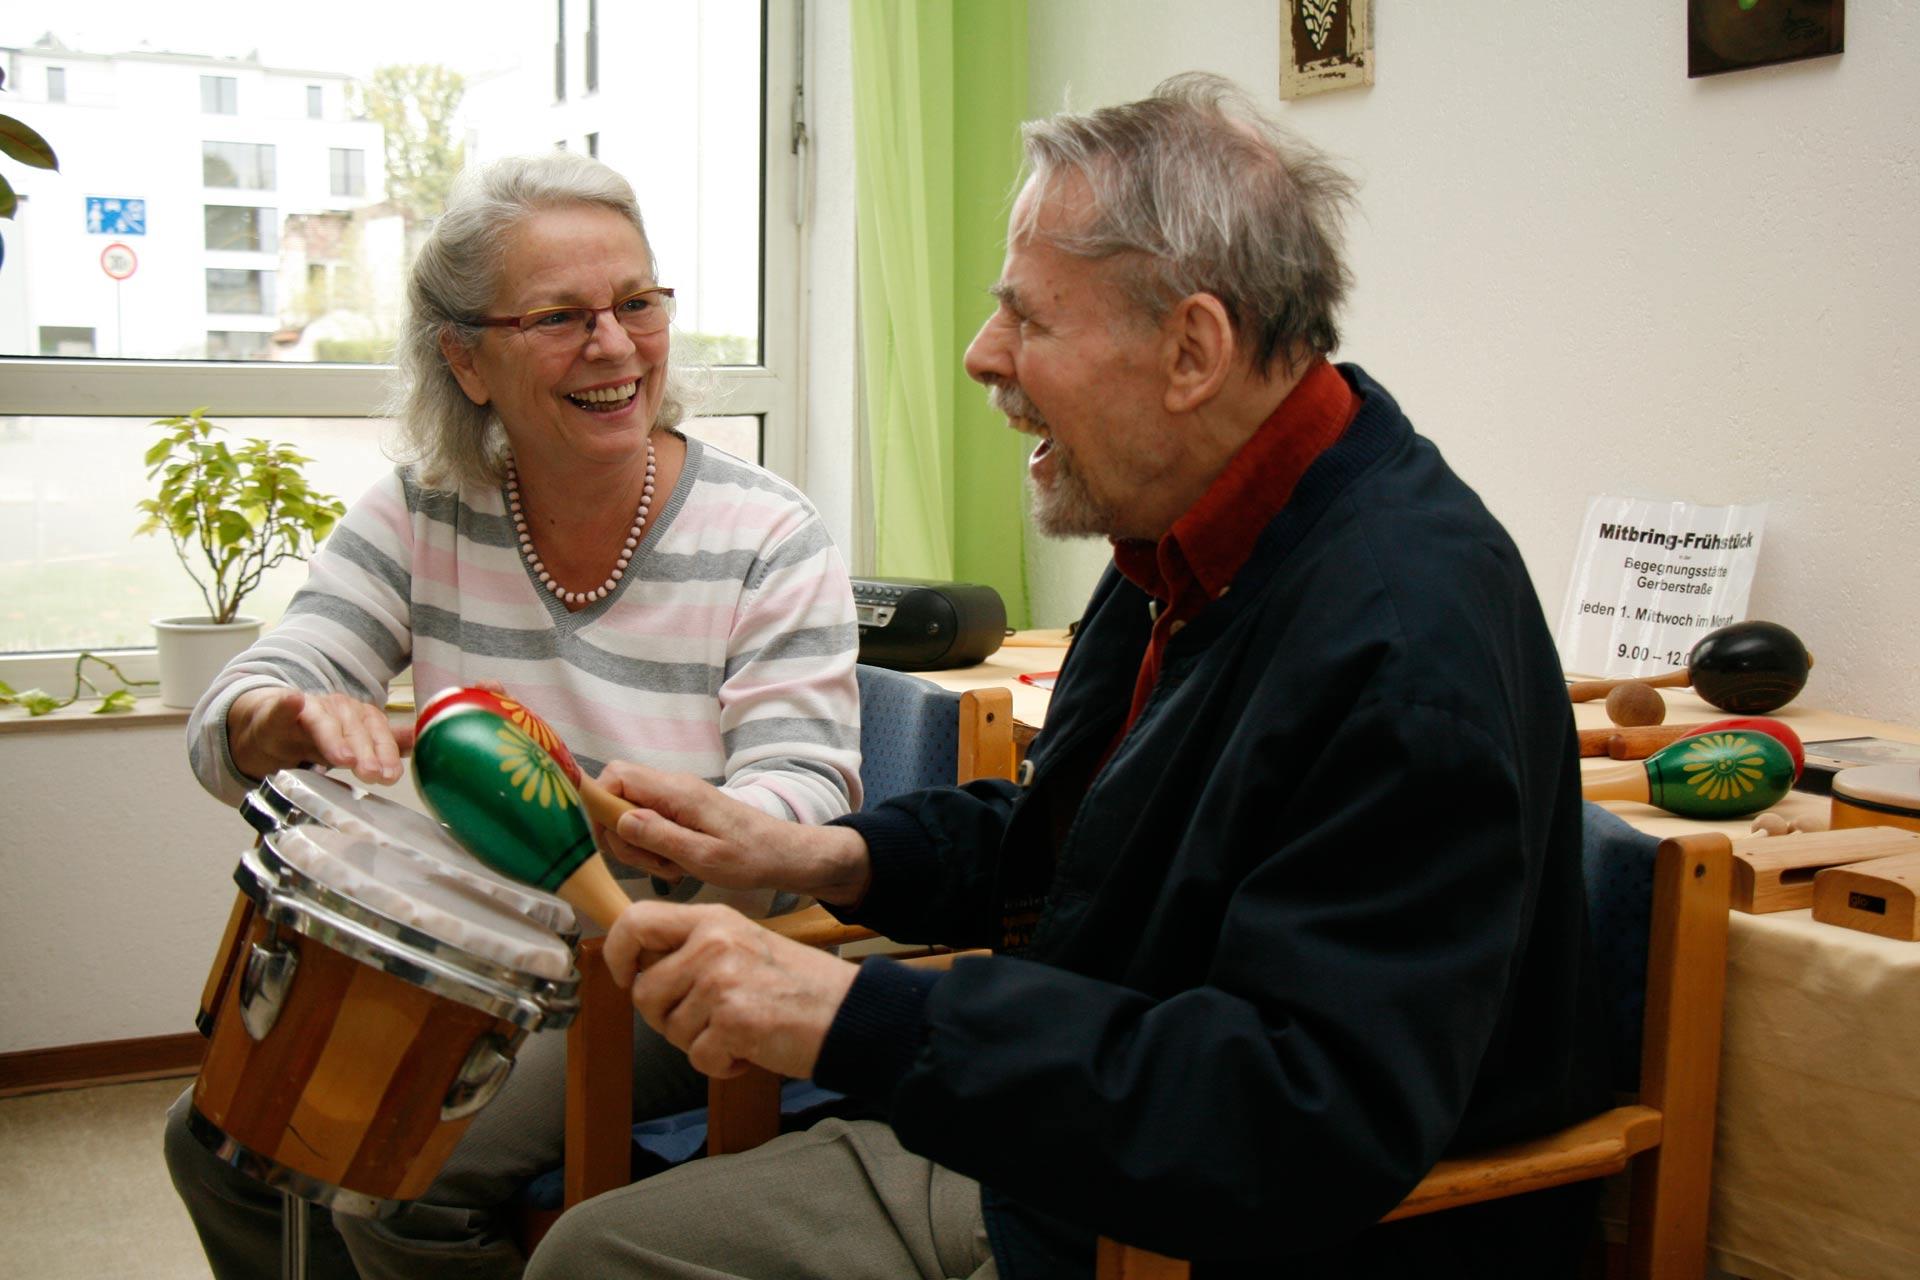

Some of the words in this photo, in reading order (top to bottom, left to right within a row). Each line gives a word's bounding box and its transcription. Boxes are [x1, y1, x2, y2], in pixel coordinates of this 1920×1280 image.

[1599, 523, 1753, 550] Mitbring-Frühstück
[1636, 576, 1712, 595] Gerberstraße
[1578, 600, 1615, 616] jeden
[1620, 605, 1630, 618] 1.
[1635, 608, 1693, 627] Mittwoch
[1695, 615, 1709, 628] im
[1617, 643, 1650, 661] 9.00
